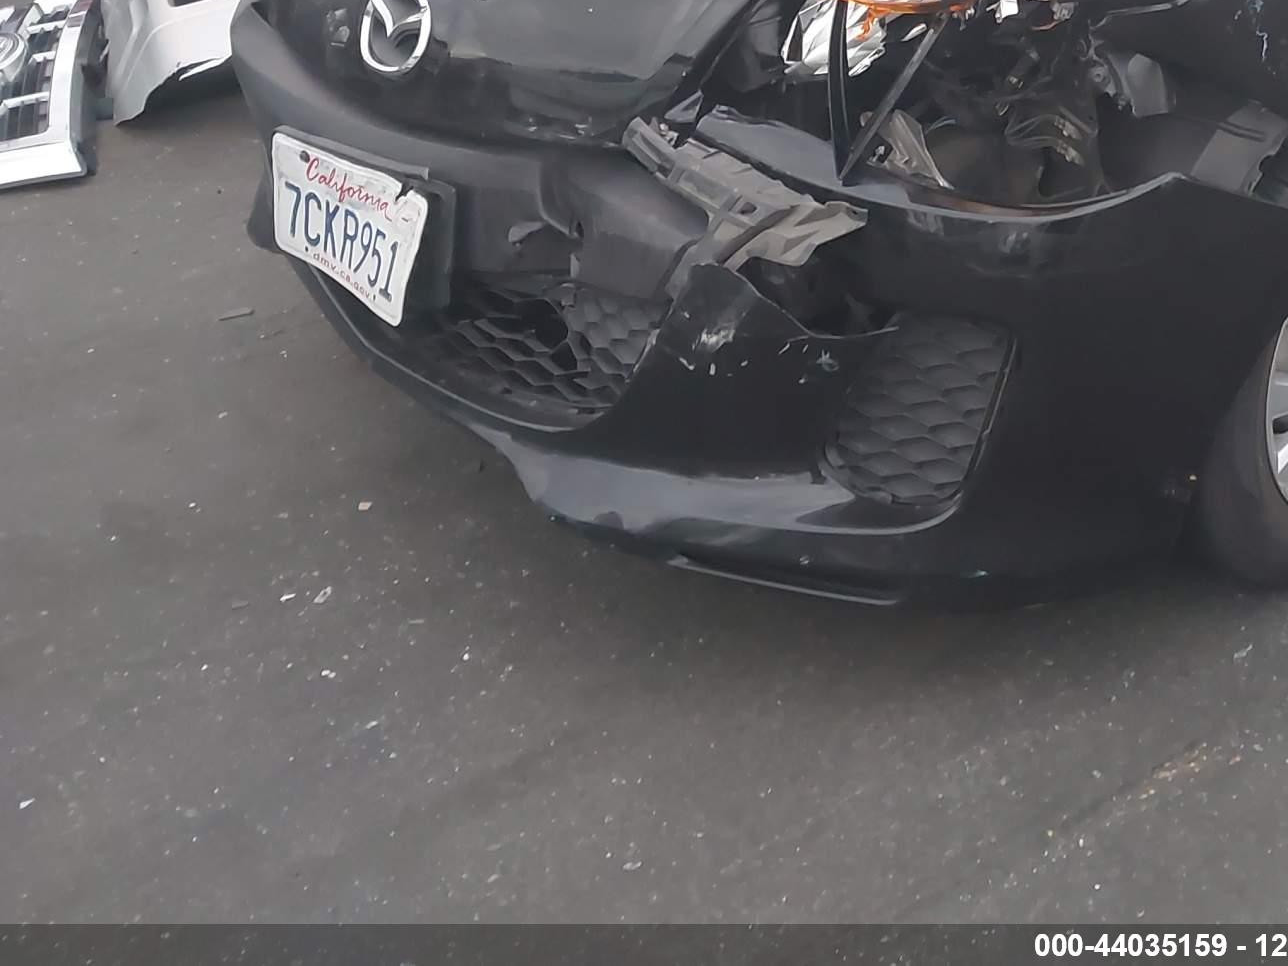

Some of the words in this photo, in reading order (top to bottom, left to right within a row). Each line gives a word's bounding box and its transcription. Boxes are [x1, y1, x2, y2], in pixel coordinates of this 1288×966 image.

[305, 157, 393, 222] California
[284, 180, 398, 302] 7CKR951
[312, 252, 372, 301] dmv.ca.gov
